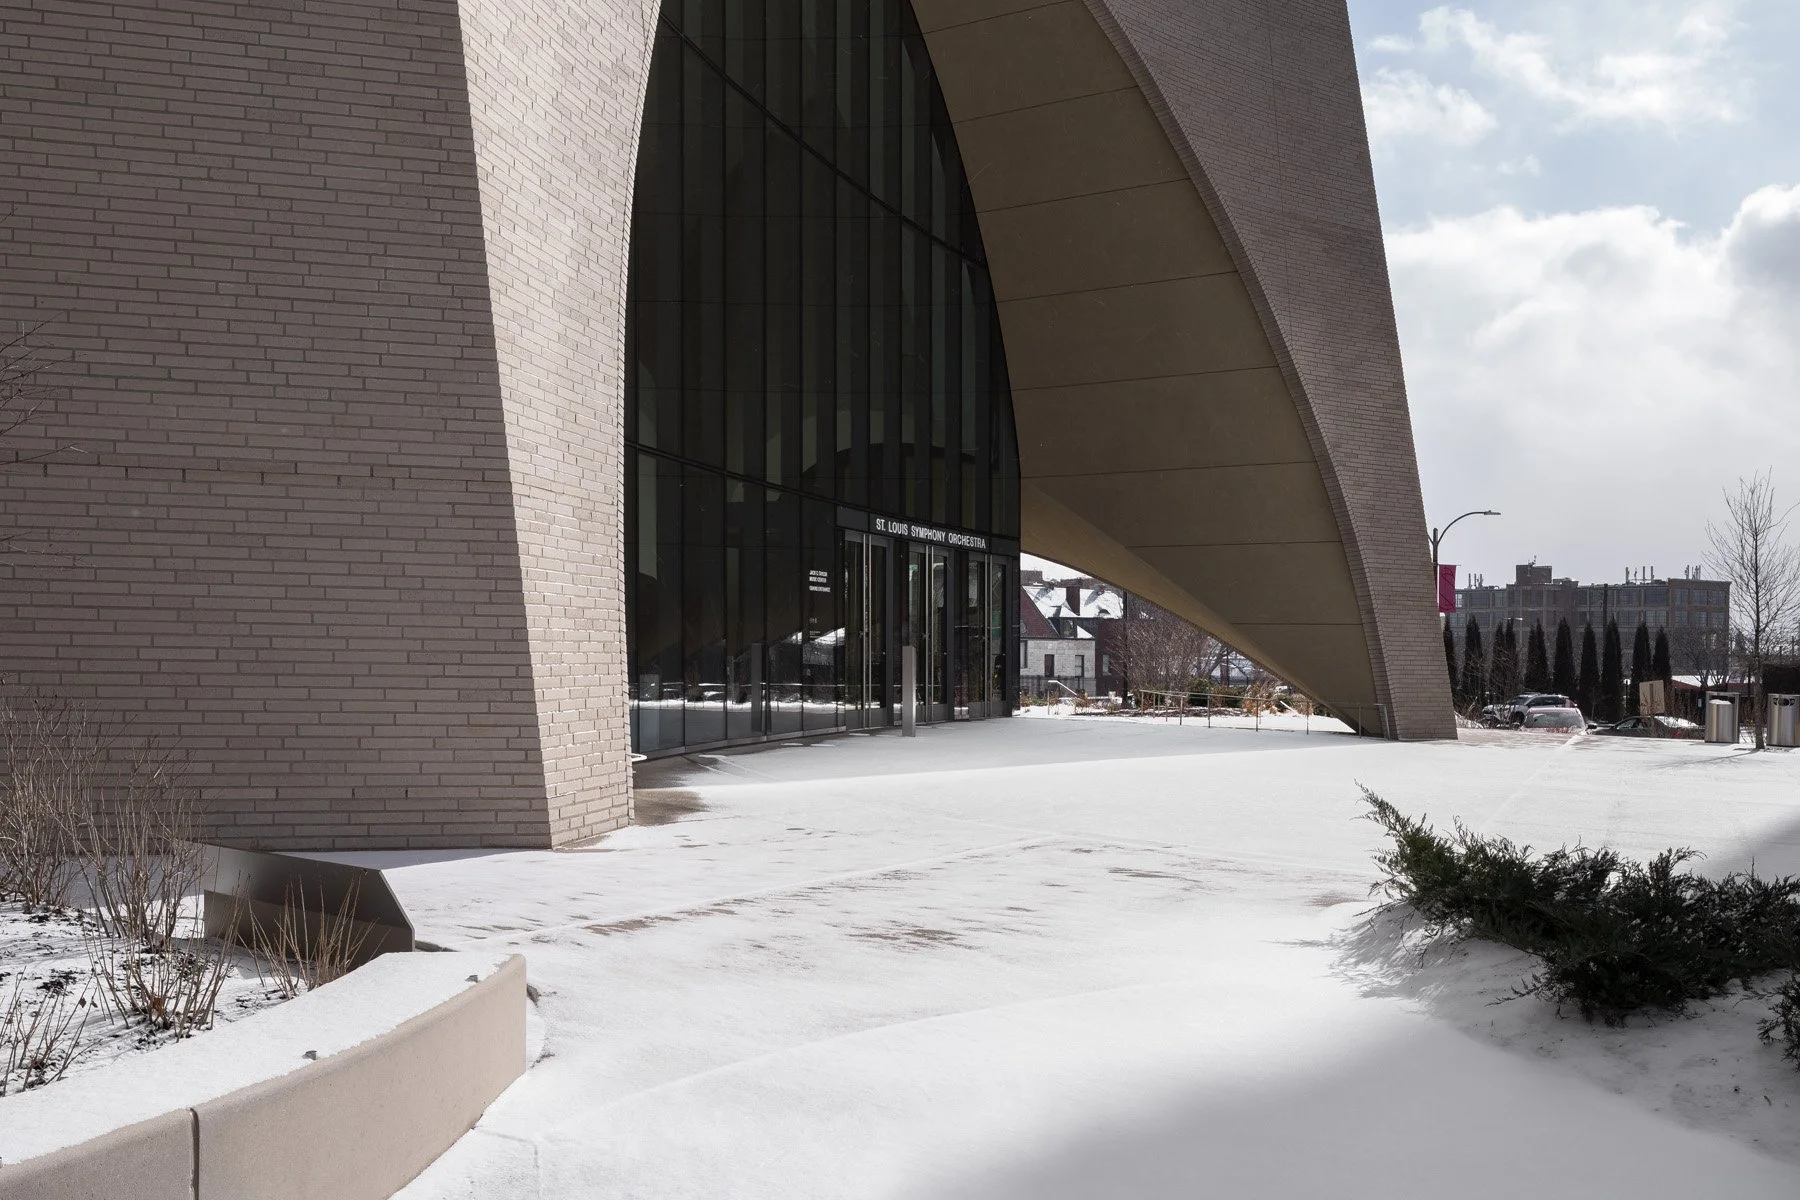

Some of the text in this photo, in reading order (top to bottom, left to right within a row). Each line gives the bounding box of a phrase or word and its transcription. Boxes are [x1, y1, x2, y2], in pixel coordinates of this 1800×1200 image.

[876, 518, 986, 549] ST. LOUIS SYMPHONY ORCHESTRA
